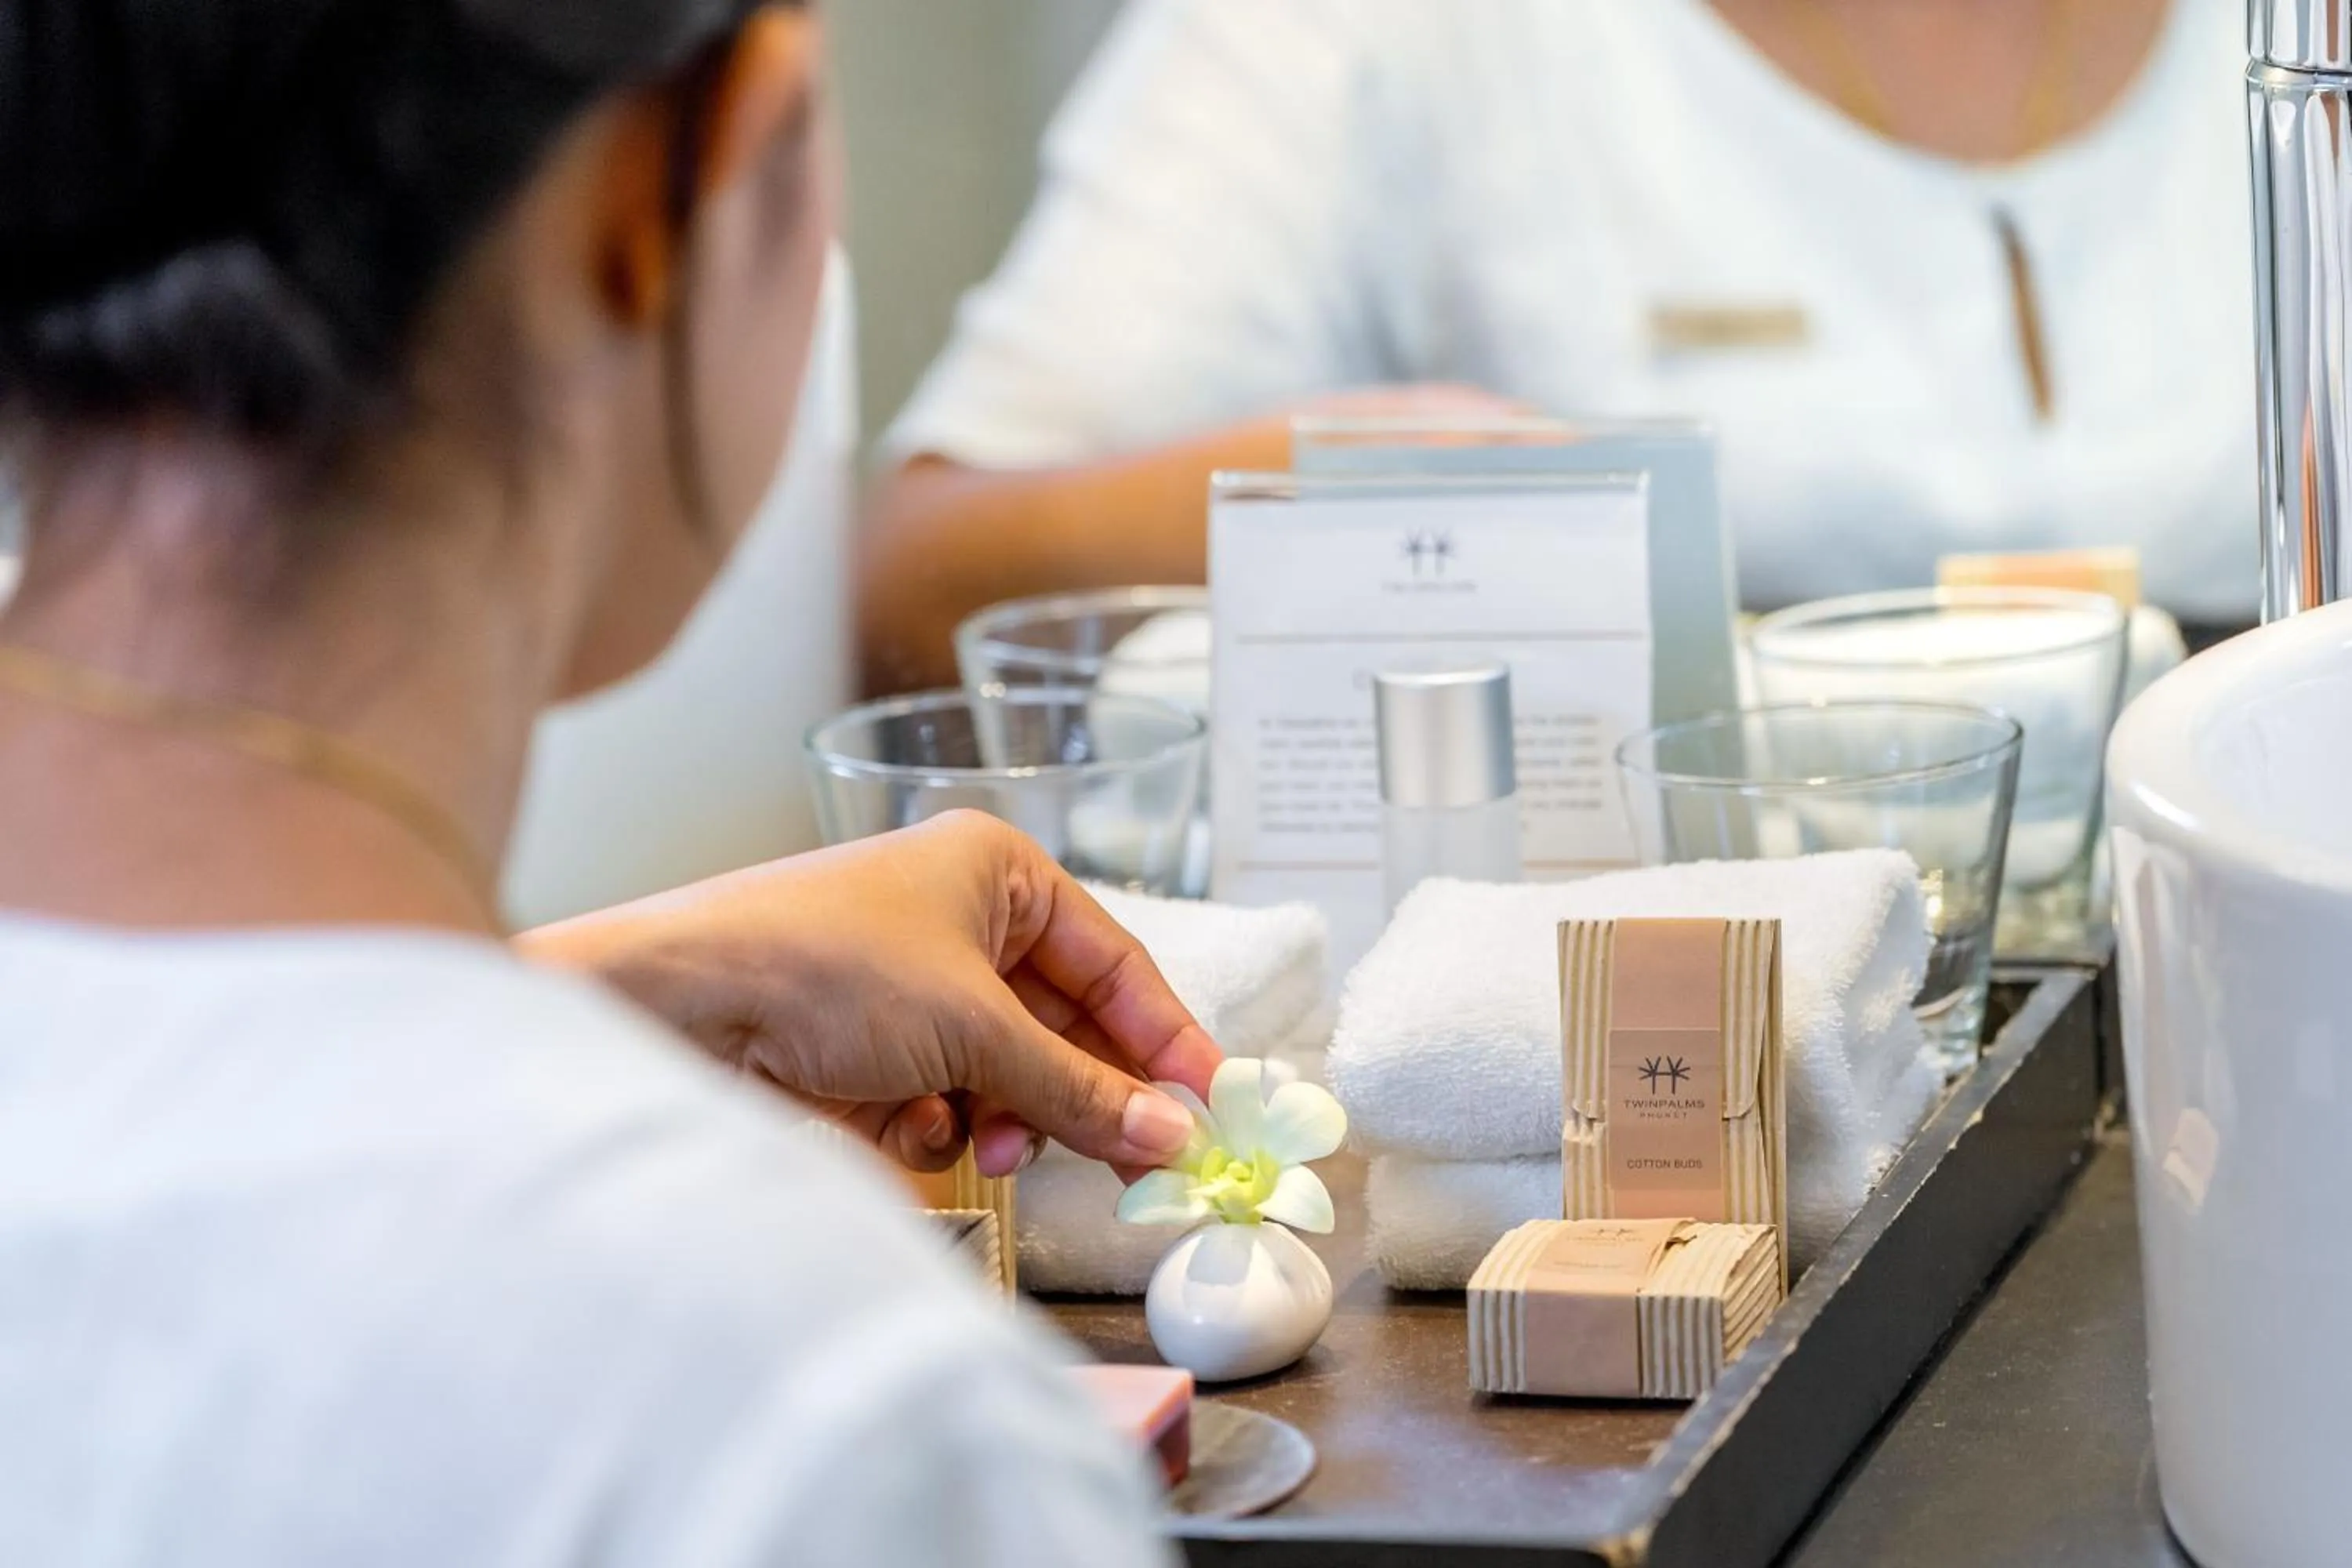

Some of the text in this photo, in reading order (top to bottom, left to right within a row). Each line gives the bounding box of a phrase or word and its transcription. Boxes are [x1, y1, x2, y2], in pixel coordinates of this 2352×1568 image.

[1624, 1099, 1705, 1109] TWINPALMS
[1626, 1159, 1704, 1169] COTTON BUDS
